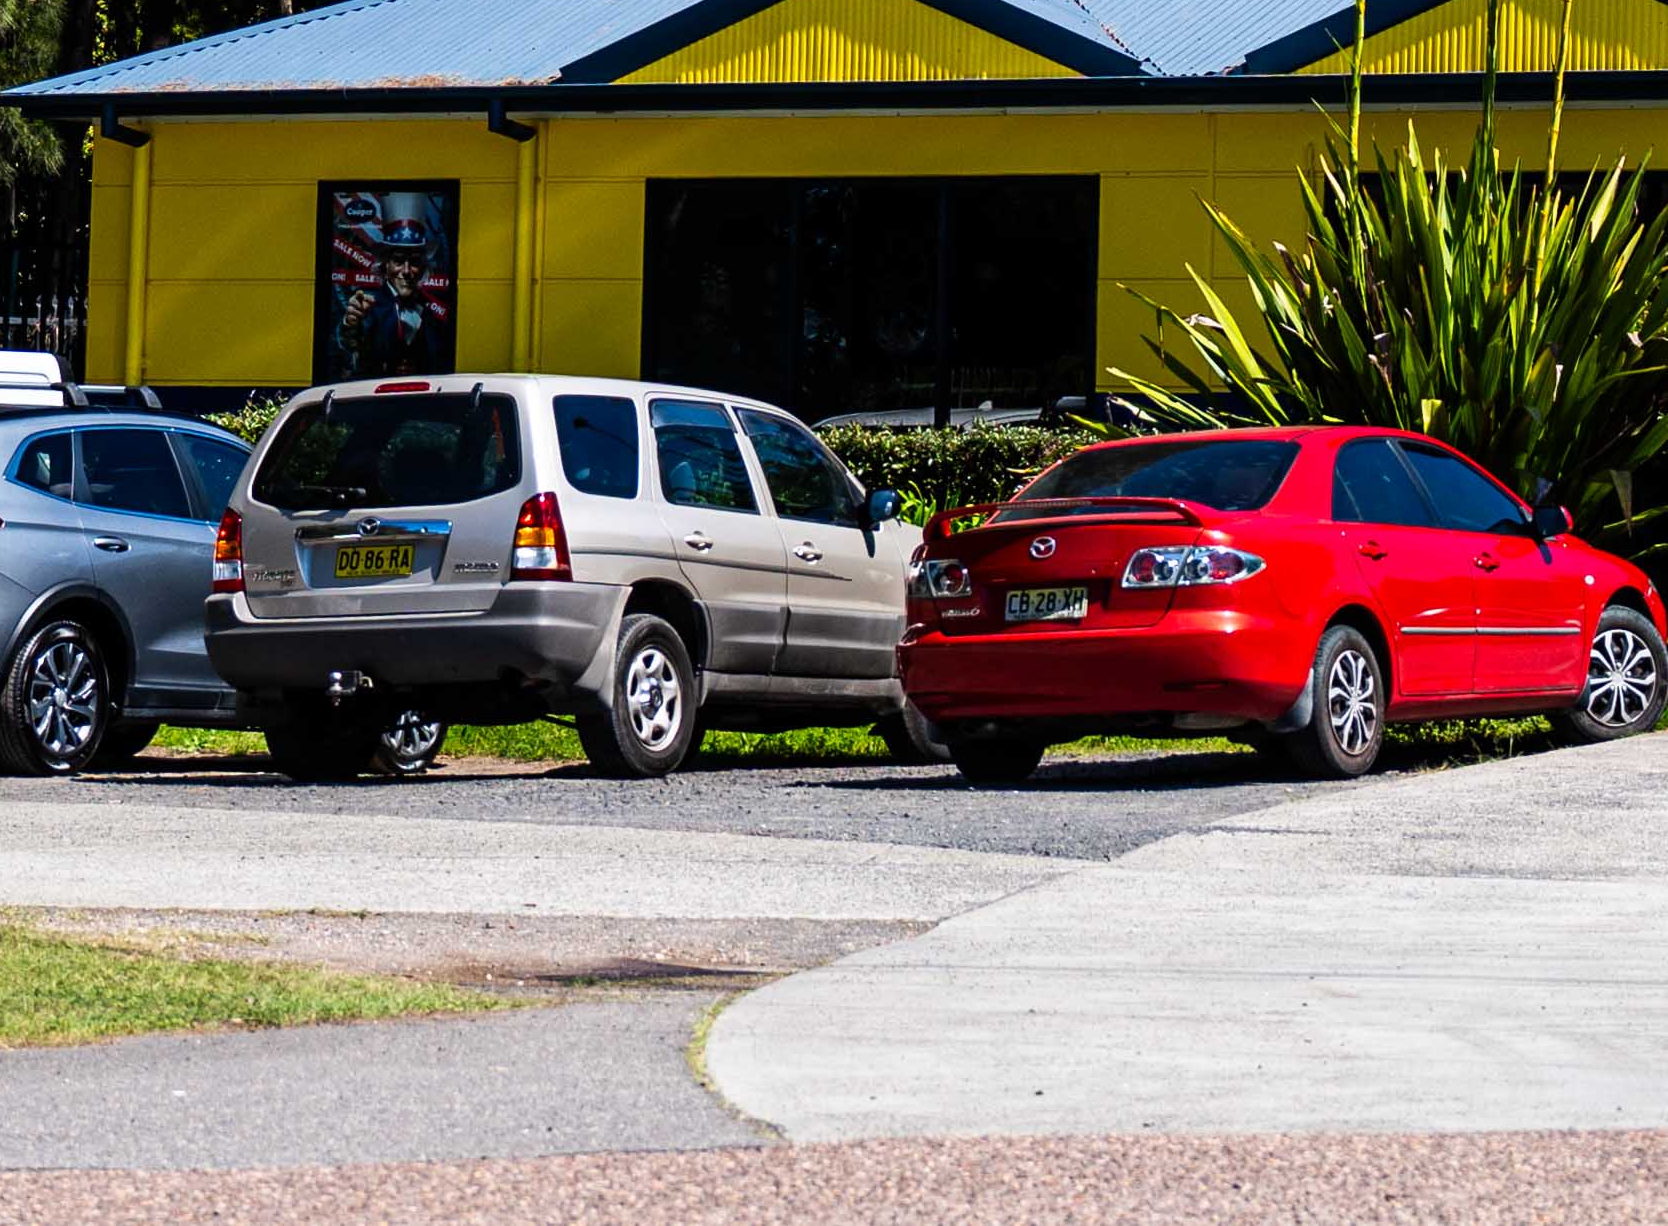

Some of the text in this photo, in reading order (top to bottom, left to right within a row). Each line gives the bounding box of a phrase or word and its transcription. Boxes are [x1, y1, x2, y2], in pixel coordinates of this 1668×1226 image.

[346, 207, 374, 217] Cooper
[334, 239, 373, 268] SALE NOW
